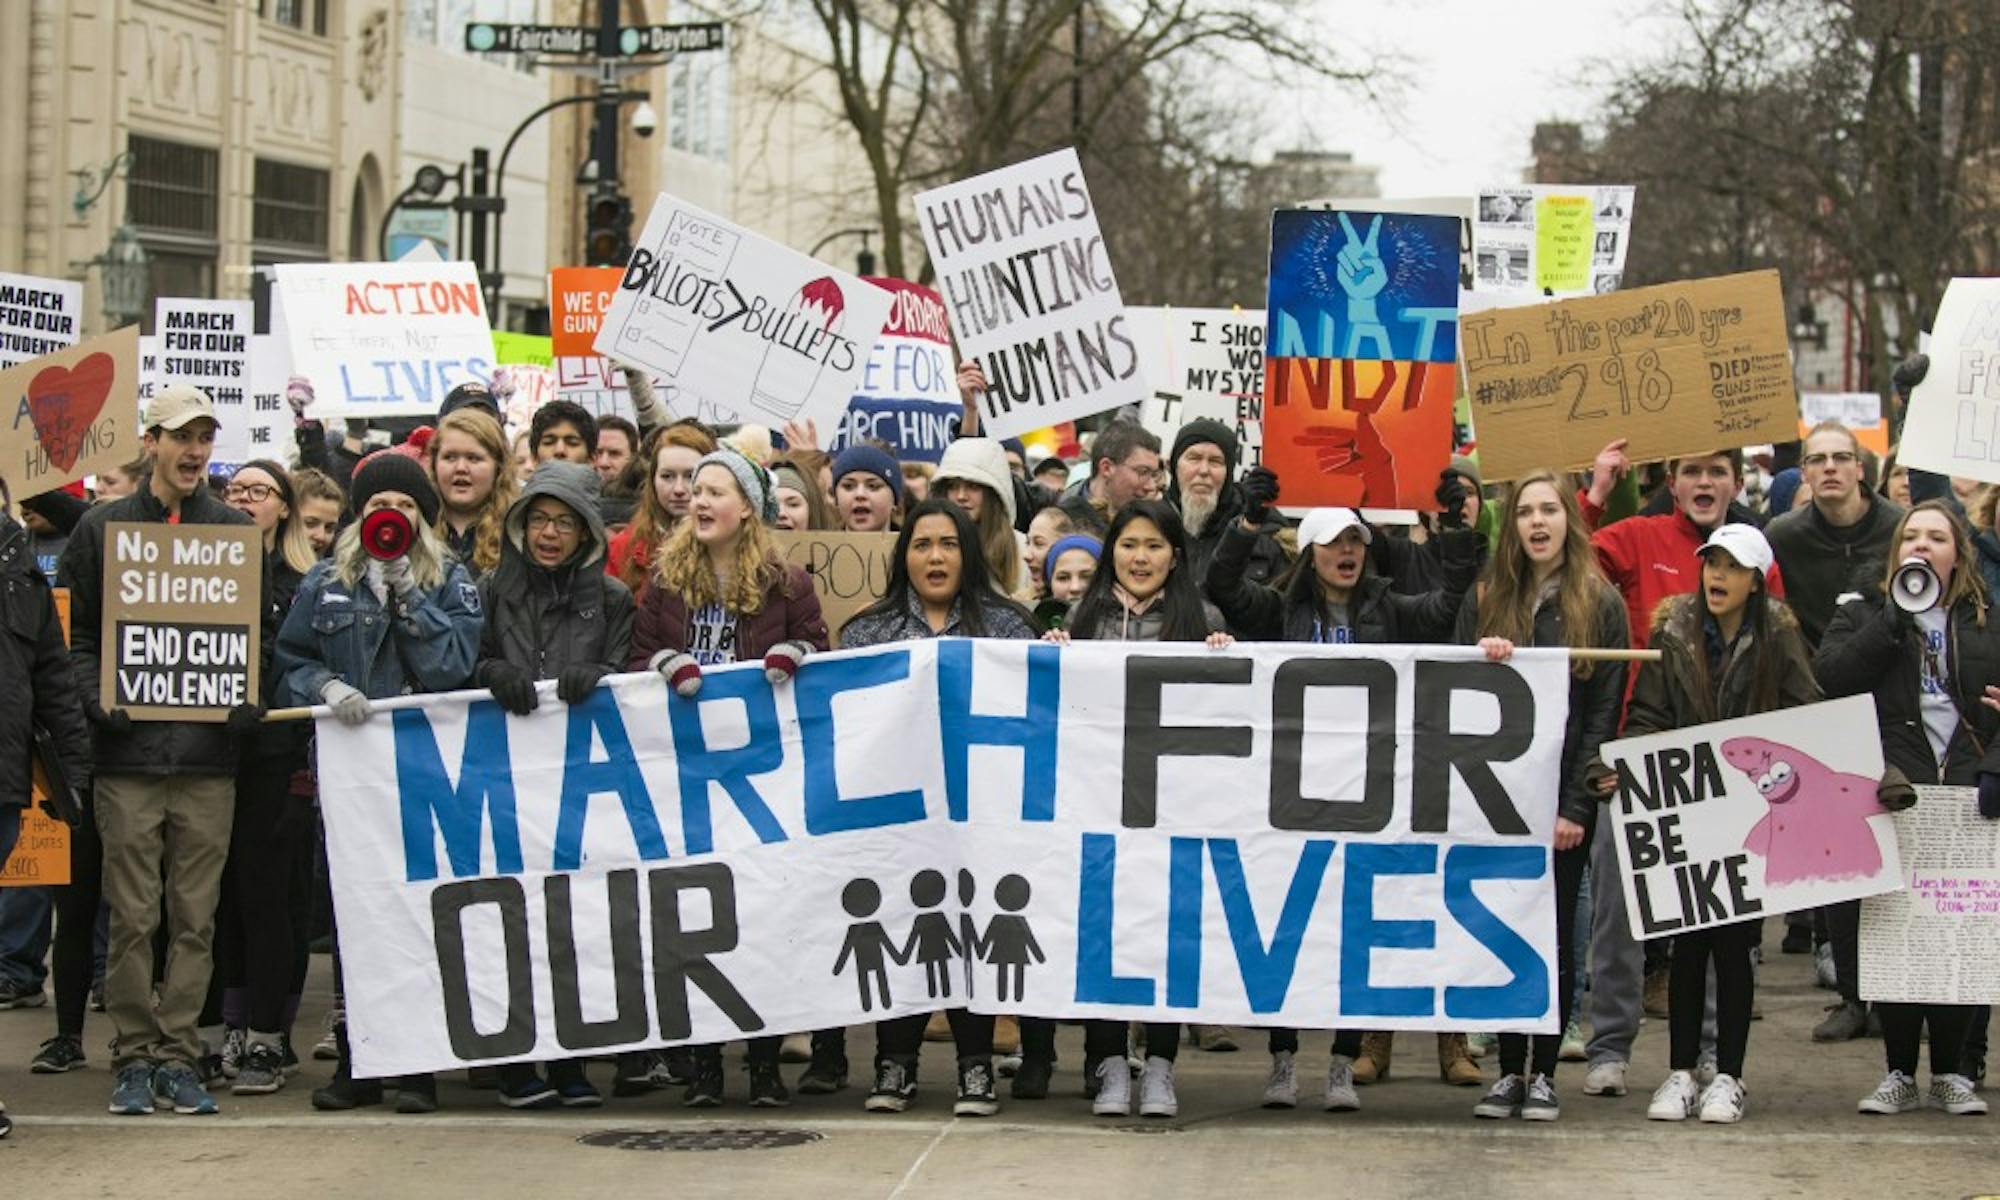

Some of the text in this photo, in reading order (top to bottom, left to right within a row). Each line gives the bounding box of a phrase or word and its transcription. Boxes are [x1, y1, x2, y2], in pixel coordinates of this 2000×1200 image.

[511, 26, 582, 49] Fairchild
[651, 27, 707, 51] Dayton
[678, 214, 723, 246] VOTE
[927, 172, 1089, 258] HUMANS
[0, 286, 64, 312] MARCH
[346, 279, 481, 318] ACTION
[563, 291, 591, 313] WE
[944, 235, 1113, 339] HUNTING
[0, 306, 73, 335] FOR OUR
[166, 311, 235, 331] MARCH
[563, 314, 597, 334] GUN
[622, 248, 725, 321] BALLOTS
[742, 295, 858, 372] BULLETS
[166, 332, 246, 353] FOR OUR
[1190, 321, 1207, 343] I
[1465, 297, 1744, 373] In the past 20 yrs
[166, 357, 245, 377] STUDENTS'
[894, 344, 947, 393] FOR
[973, 315, 1138, 419] HUMANS
[1275, 307, 1458, 415] NOT
[1709, 358, 1751, 381] DIED
[1187, 368, 1218, 392] MY
[1559, 349, 1674, 422] 298
[1711, 380, 1751, 399] GUNS
[254, 394, 280, 411] THE
[116, 530, 246, 567] No More
[120, 570, 240, 605] Silence
[123, 624, 248, 667] END GUN
[118, 668, 246, 707] VIOLENCE
[391, 638, 1536, 882] MARCH FOR
[1614, 741, 1727, 815] NRA
[1624, 814, 1687, 871] BE
[1633, 854, 1763, 935] LIKE
[430, 832, 1551, 1061] OUR LIVES
